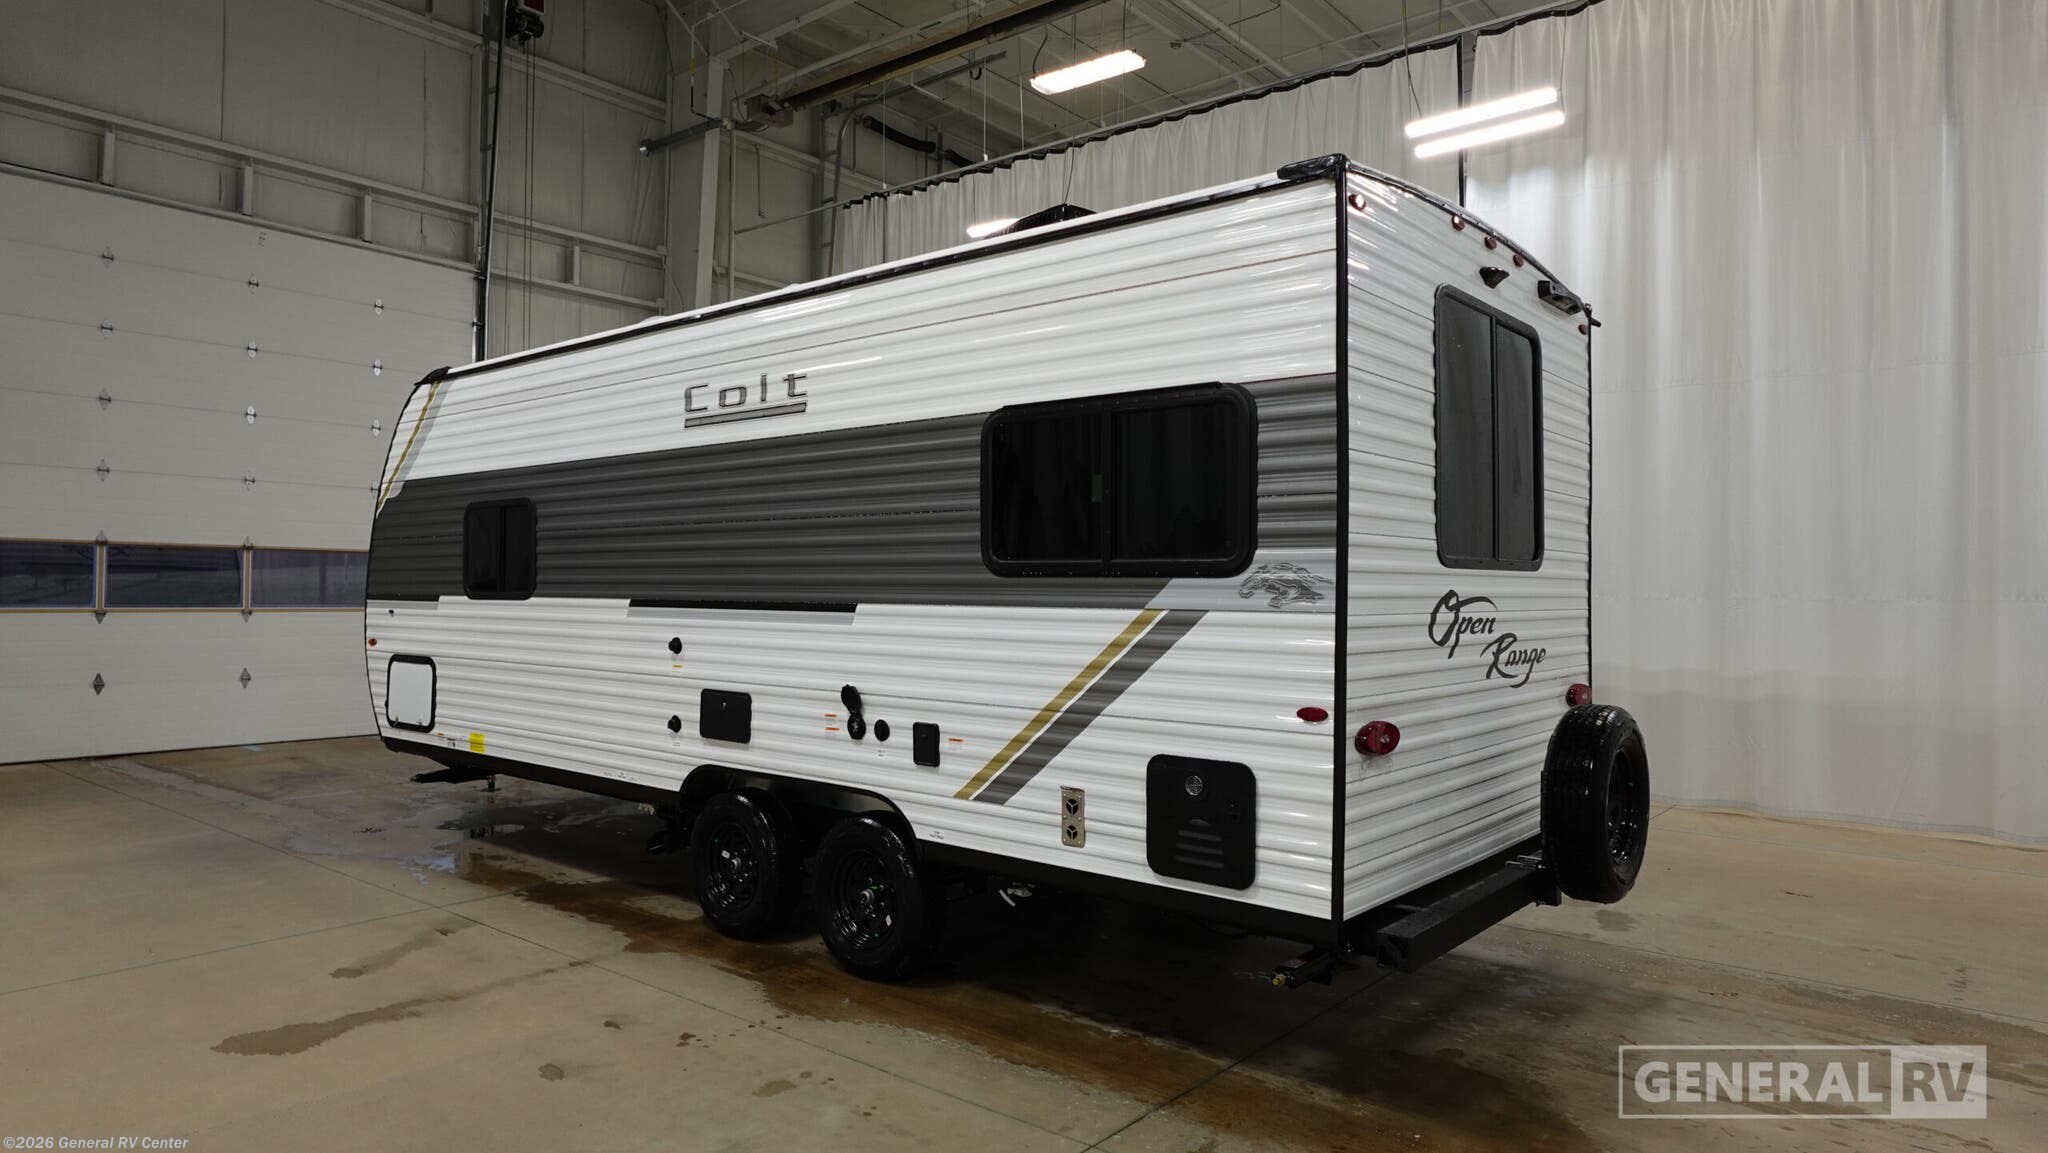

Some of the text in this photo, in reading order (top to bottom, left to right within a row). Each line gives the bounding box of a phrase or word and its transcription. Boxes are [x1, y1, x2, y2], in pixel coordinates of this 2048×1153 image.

[684, 372, 808, 413] Colt
[1428, 589, 1499, 659] Open
[1480, 632, 1547, 688] Range
